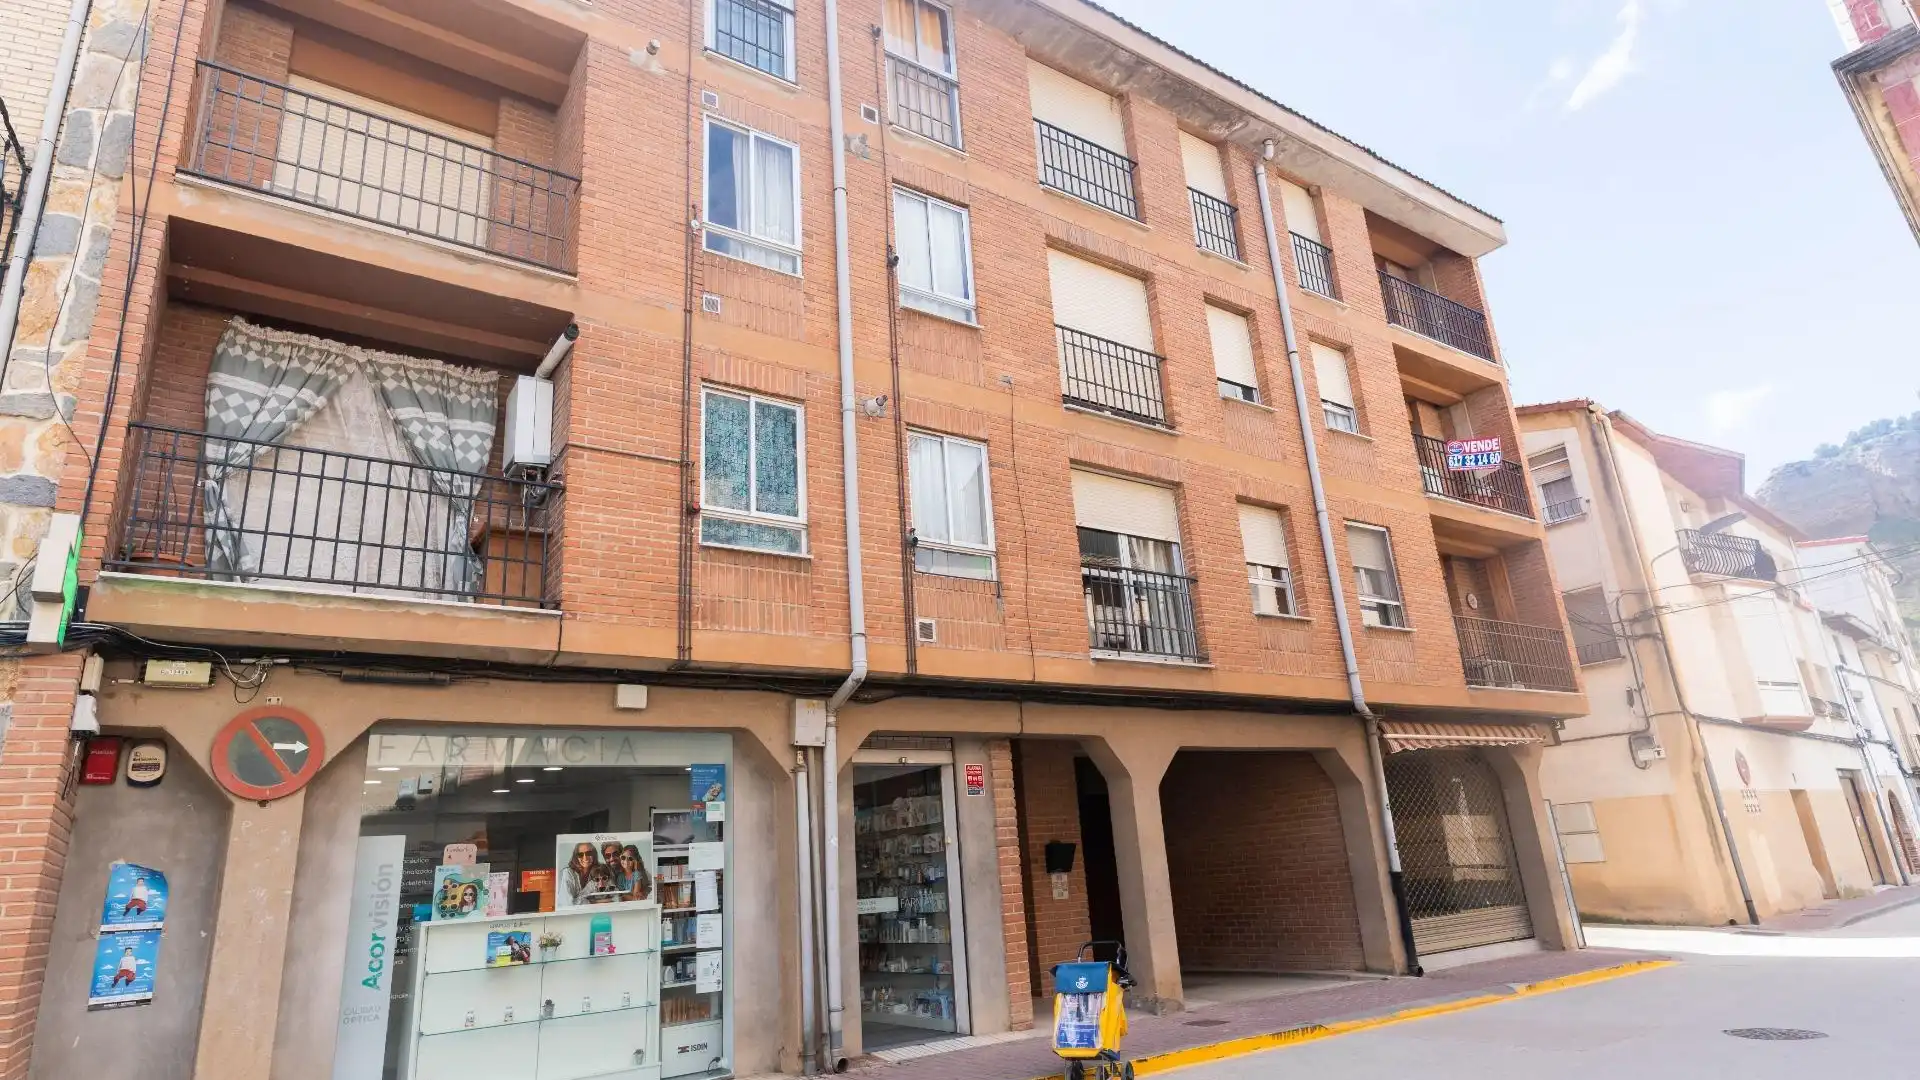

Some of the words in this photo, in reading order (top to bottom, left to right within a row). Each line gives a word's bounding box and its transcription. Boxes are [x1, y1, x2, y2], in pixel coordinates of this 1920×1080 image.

[1463, 438, 1499, 452] VENDE
[1448, 454, 1462, 467] 617
[1465, 453, 1475, 466] 32
[1478, 452, 1488, 465] 14
[1489, 451, 1500, 464] 60
[377, 733, 638, 763] FARMACIA
[690, 1042, 708, 1052] ISDIN
